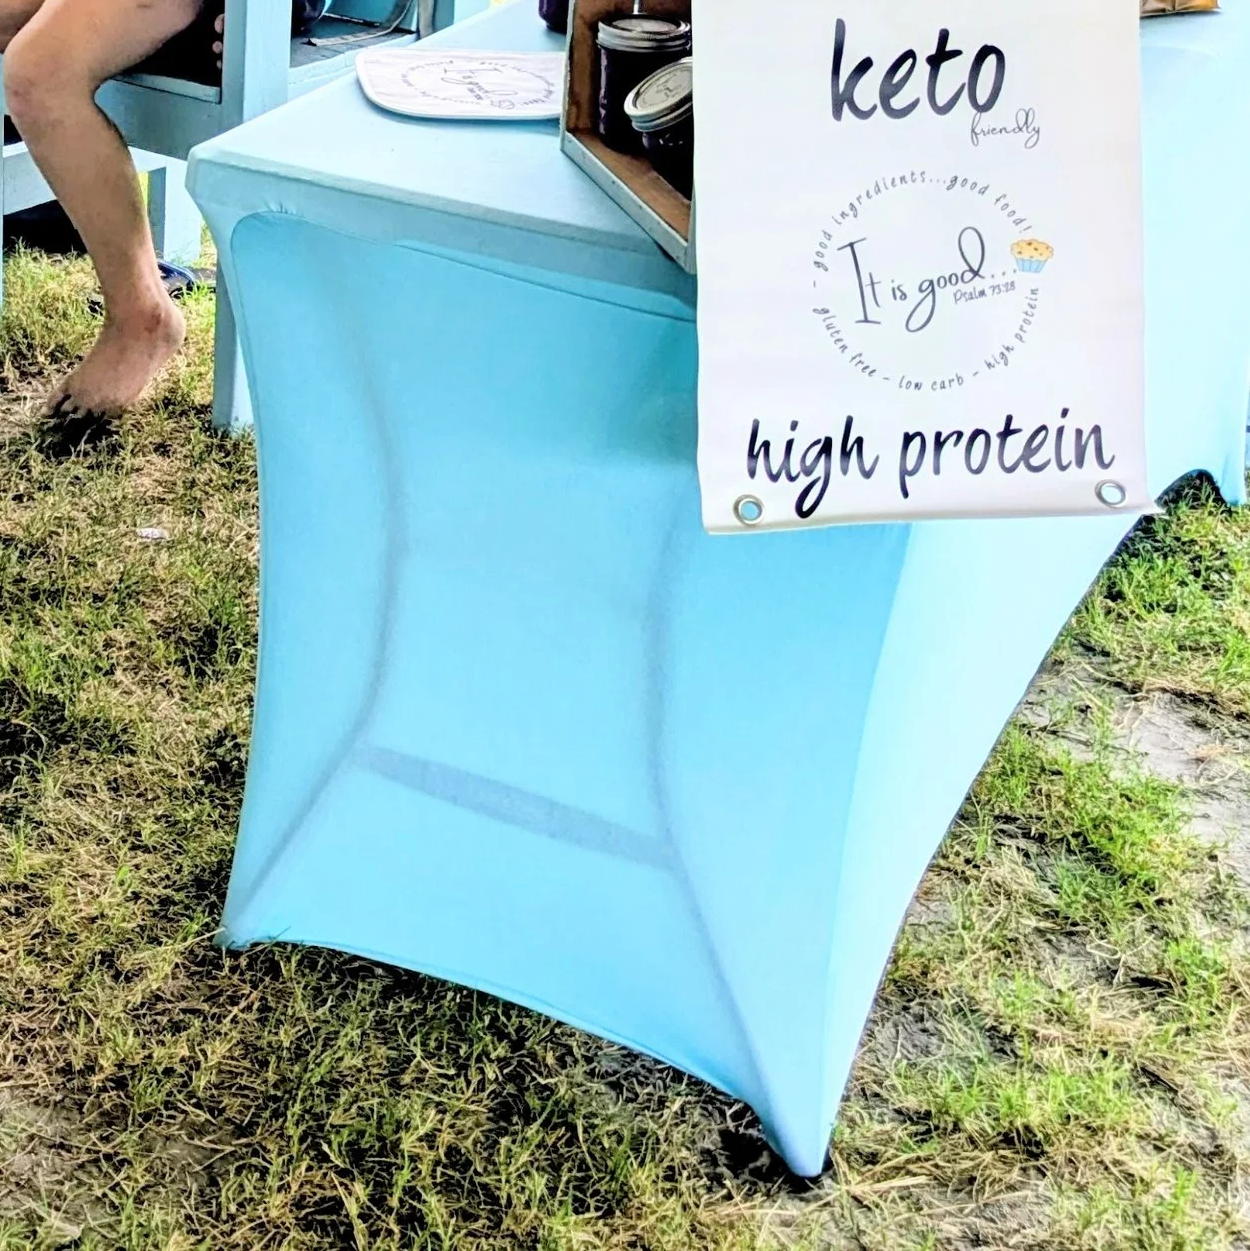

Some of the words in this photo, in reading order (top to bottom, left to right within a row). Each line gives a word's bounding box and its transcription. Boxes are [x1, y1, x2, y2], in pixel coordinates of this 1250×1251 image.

[831, 18, 1006, 122] keto
[970, 107, 1040, 149] friendly
[813, 230, 833, 272] good
[994, 194, 1032, 233] food!
[836, 237, 882, 325] It
[891, 280, 907, 301] is
[953, 287, 987, 304] Psalm
[989, 281, 1016, 296] 73:28
[812, 308, 848, 353] gluten
[849, 353, 877, 377] free
[899, 375, 922, 391] low
[931, 373, 964, 391] carb
[984, 344, 1015, 370] high
[1014, 287, 1039, 343] protein
[747, 414, 879, 519] high
[900, 408, 1115, 499] protein
